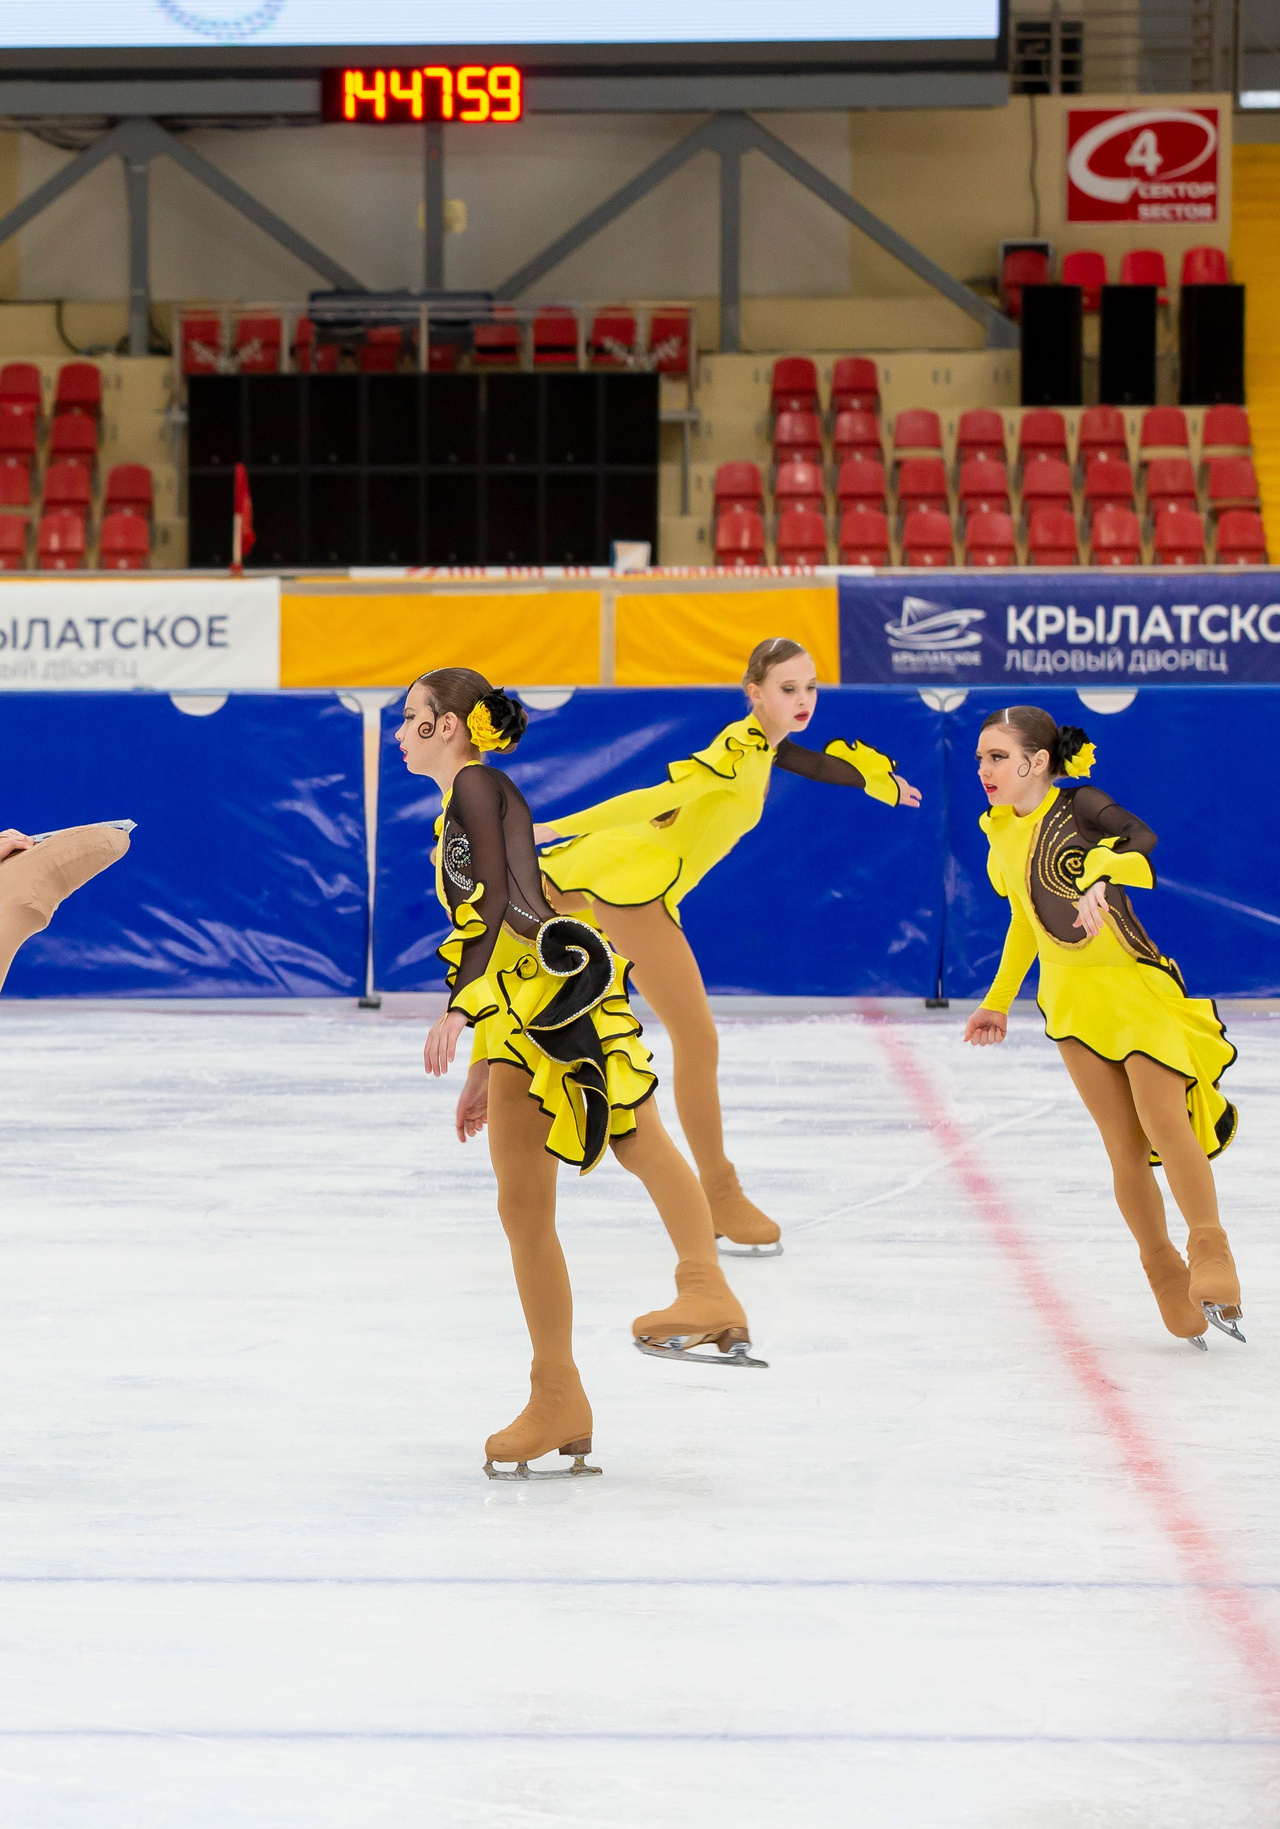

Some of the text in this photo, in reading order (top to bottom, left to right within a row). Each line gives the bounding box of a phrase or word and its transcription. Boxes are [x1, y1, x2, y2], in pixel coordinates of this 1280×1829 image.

[1124, 129, 1164, 176] 4
[1137, 181, 1216, 199] СЕКТОР
[1137, 203, 1213, 220] SECTOR
[42, 657, 139, 681] ДВОРЕЦ
[1004, 646, 1229, 675] ЛЕДОВЫЙ ДВОРЕЦ
